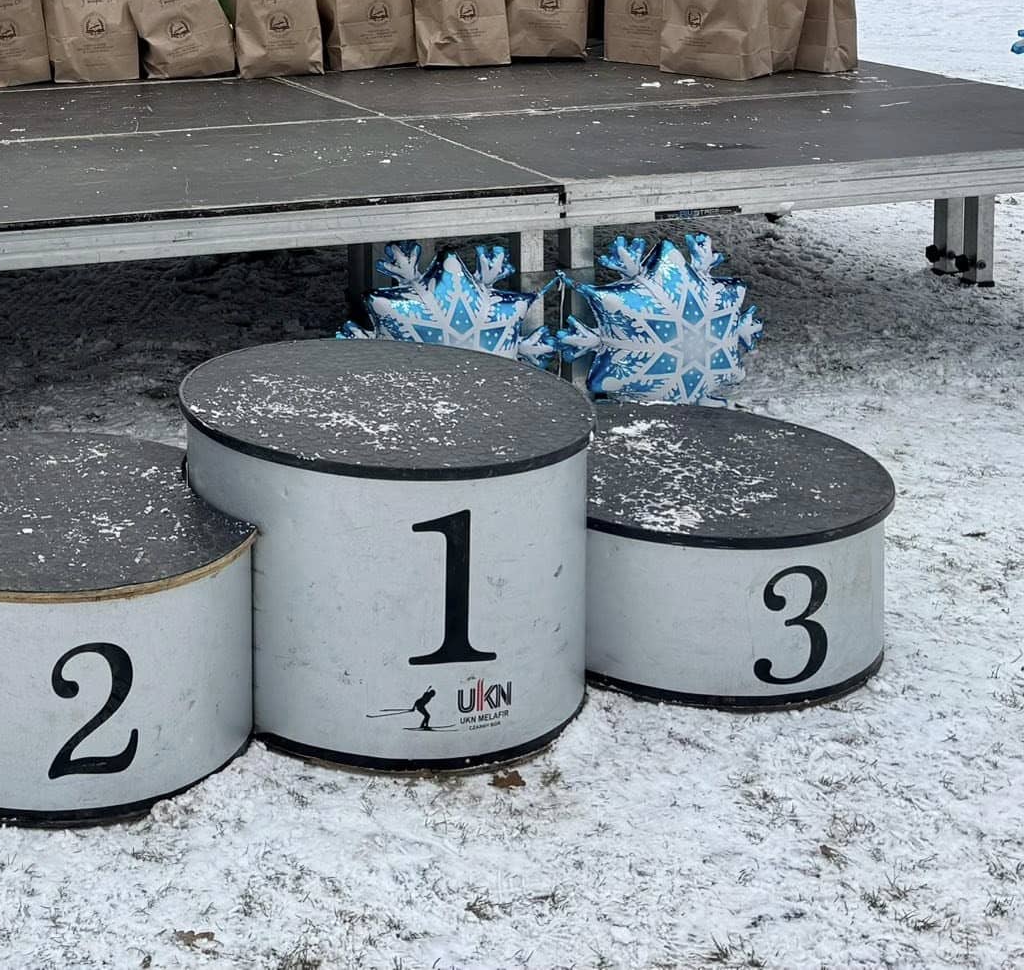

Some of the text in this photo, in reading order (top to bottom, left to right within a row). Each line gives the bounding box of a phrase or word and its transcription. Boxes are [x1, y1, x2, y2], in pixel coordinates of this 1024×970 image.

[408, 509, 497, 666] 1
[753, 565, 828, 685] 3
[48, 642, 139, 780] 2
[457, 678, 512, 714] UKN
[460, 710, 509, 724] UKN MELAFIR
